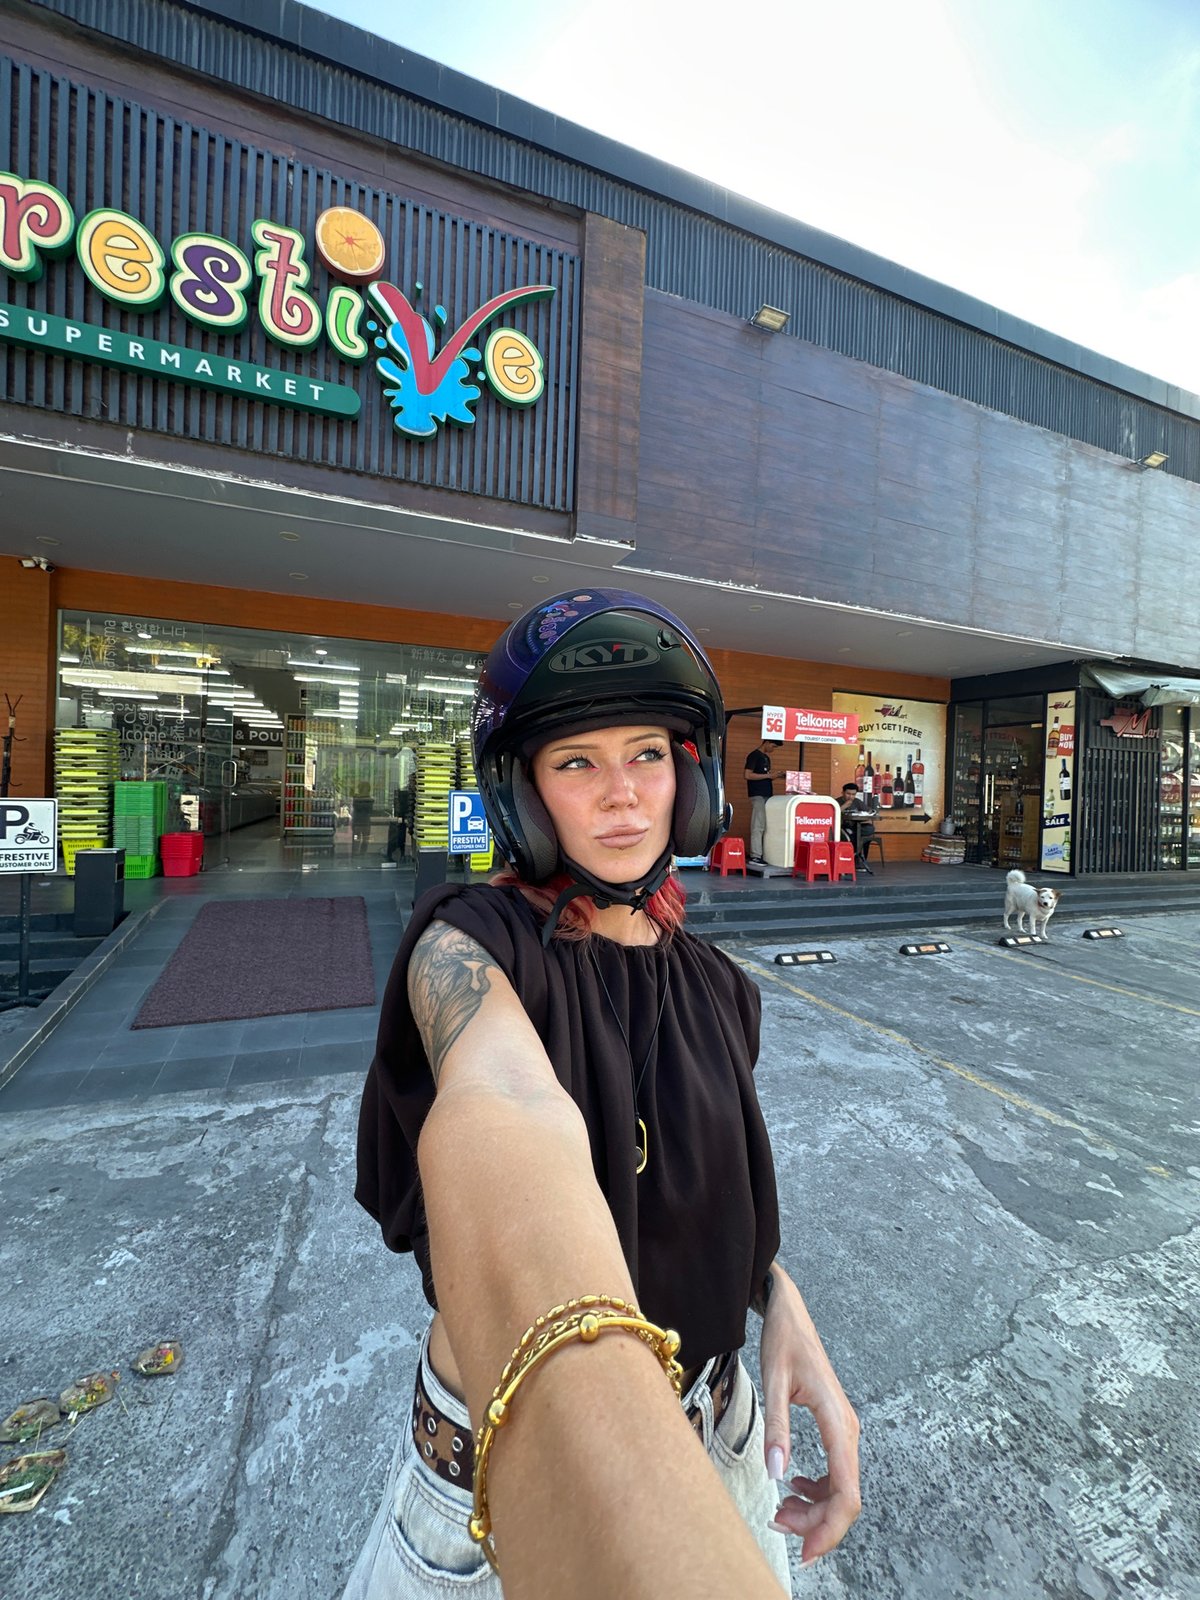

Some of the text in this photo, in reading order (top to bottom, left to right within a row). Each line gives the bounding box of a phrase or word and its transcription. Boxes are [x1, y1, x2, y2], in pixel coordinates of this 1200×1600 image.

[561, 643, 646, 671] KYT
[766, 718, 782, 732] 5G
[795, 712, 847, 729] Telkomsel
[235, 730, 245, 740] &
[858, 723, 923, 738] BUY 1 GET 1 FREE
[1060, 733, 1073, 741] BUY
[454, 796, 473, 832] P
[795, 815, 833, 825] Telkomsel
[0, 805, 29, 839] P
[1045, 818, 1065, 826] SALE
[453, 837, 486, 845] FRESTIVE
